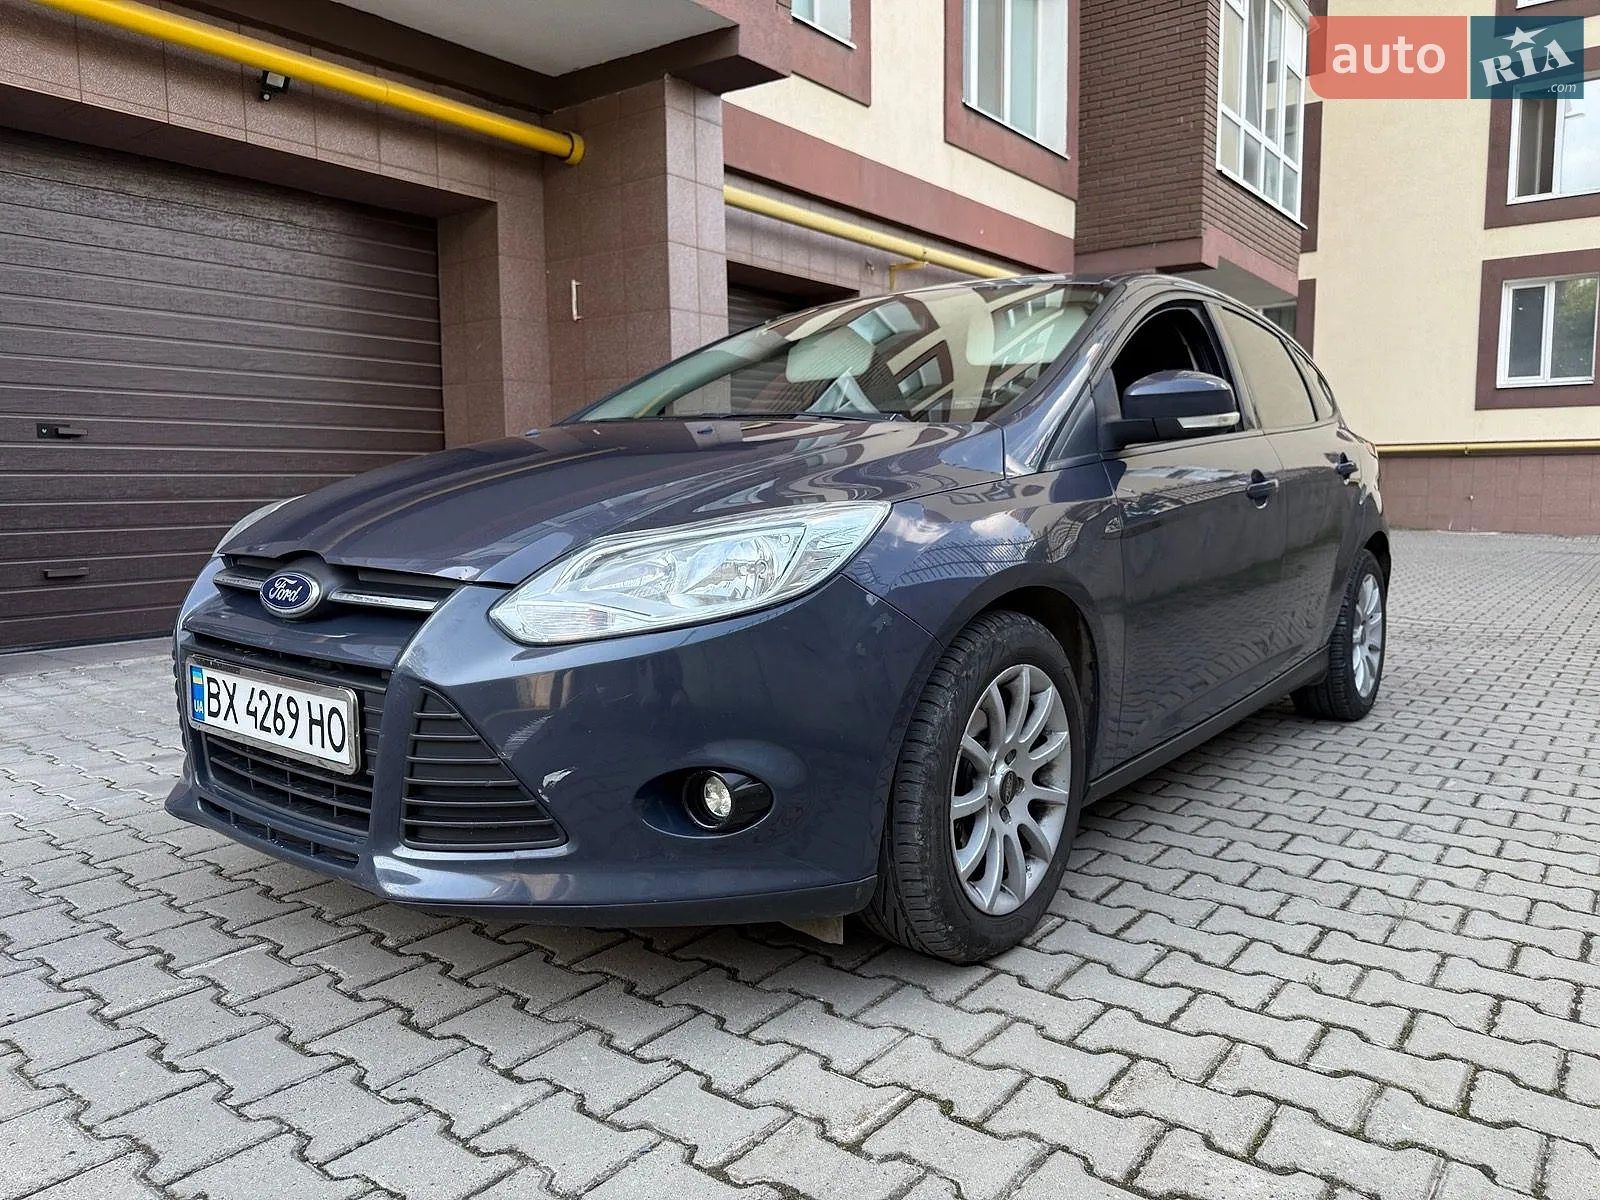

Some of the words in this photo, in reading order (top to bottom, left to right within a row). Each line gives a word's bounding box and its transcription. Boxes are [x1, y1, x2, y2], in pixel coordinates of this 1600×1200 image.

[268, 577, 303, 602] Ford
[193, 699, 204, 713] UA
[206, 676, 239, 724] BX
[245, 686, 300, 740] 4269
[307, 700, 346, 753] HO
